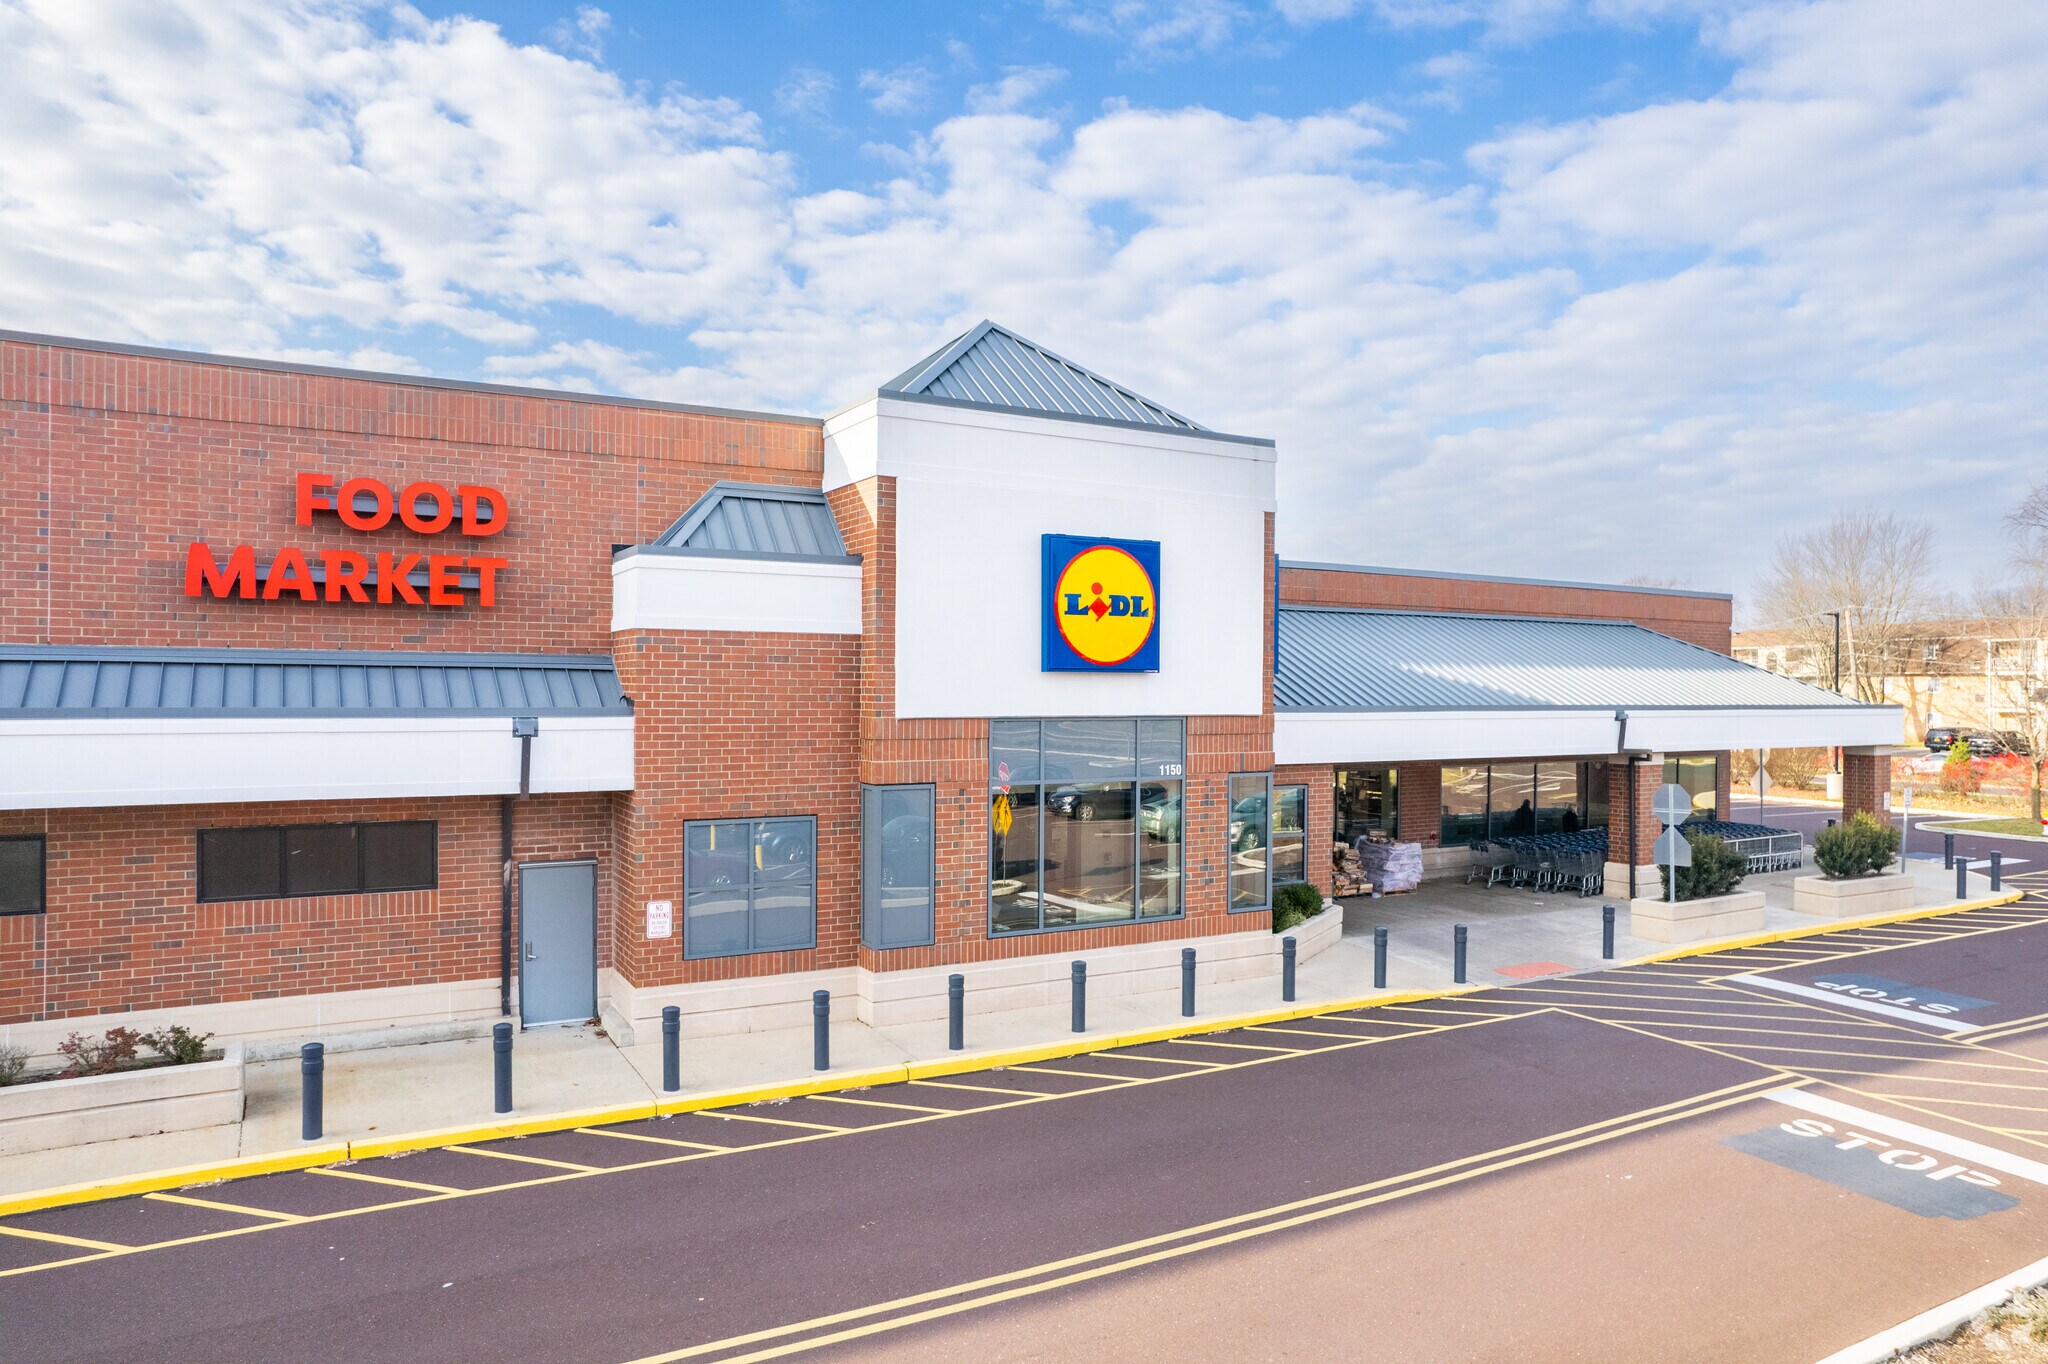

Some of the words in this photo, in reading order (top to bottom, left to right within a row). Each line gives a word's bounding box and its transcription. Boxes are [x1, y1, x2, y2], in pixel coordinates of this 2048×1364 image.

[296, 472, 509, 536] FOOD
[185, 542, 508, 607] MARKET
[1159, 764, 1182, 776] 1150
[1814, 981, 1960, 1014] STOP
[1779, 1118, 2002, 1187] STOP
